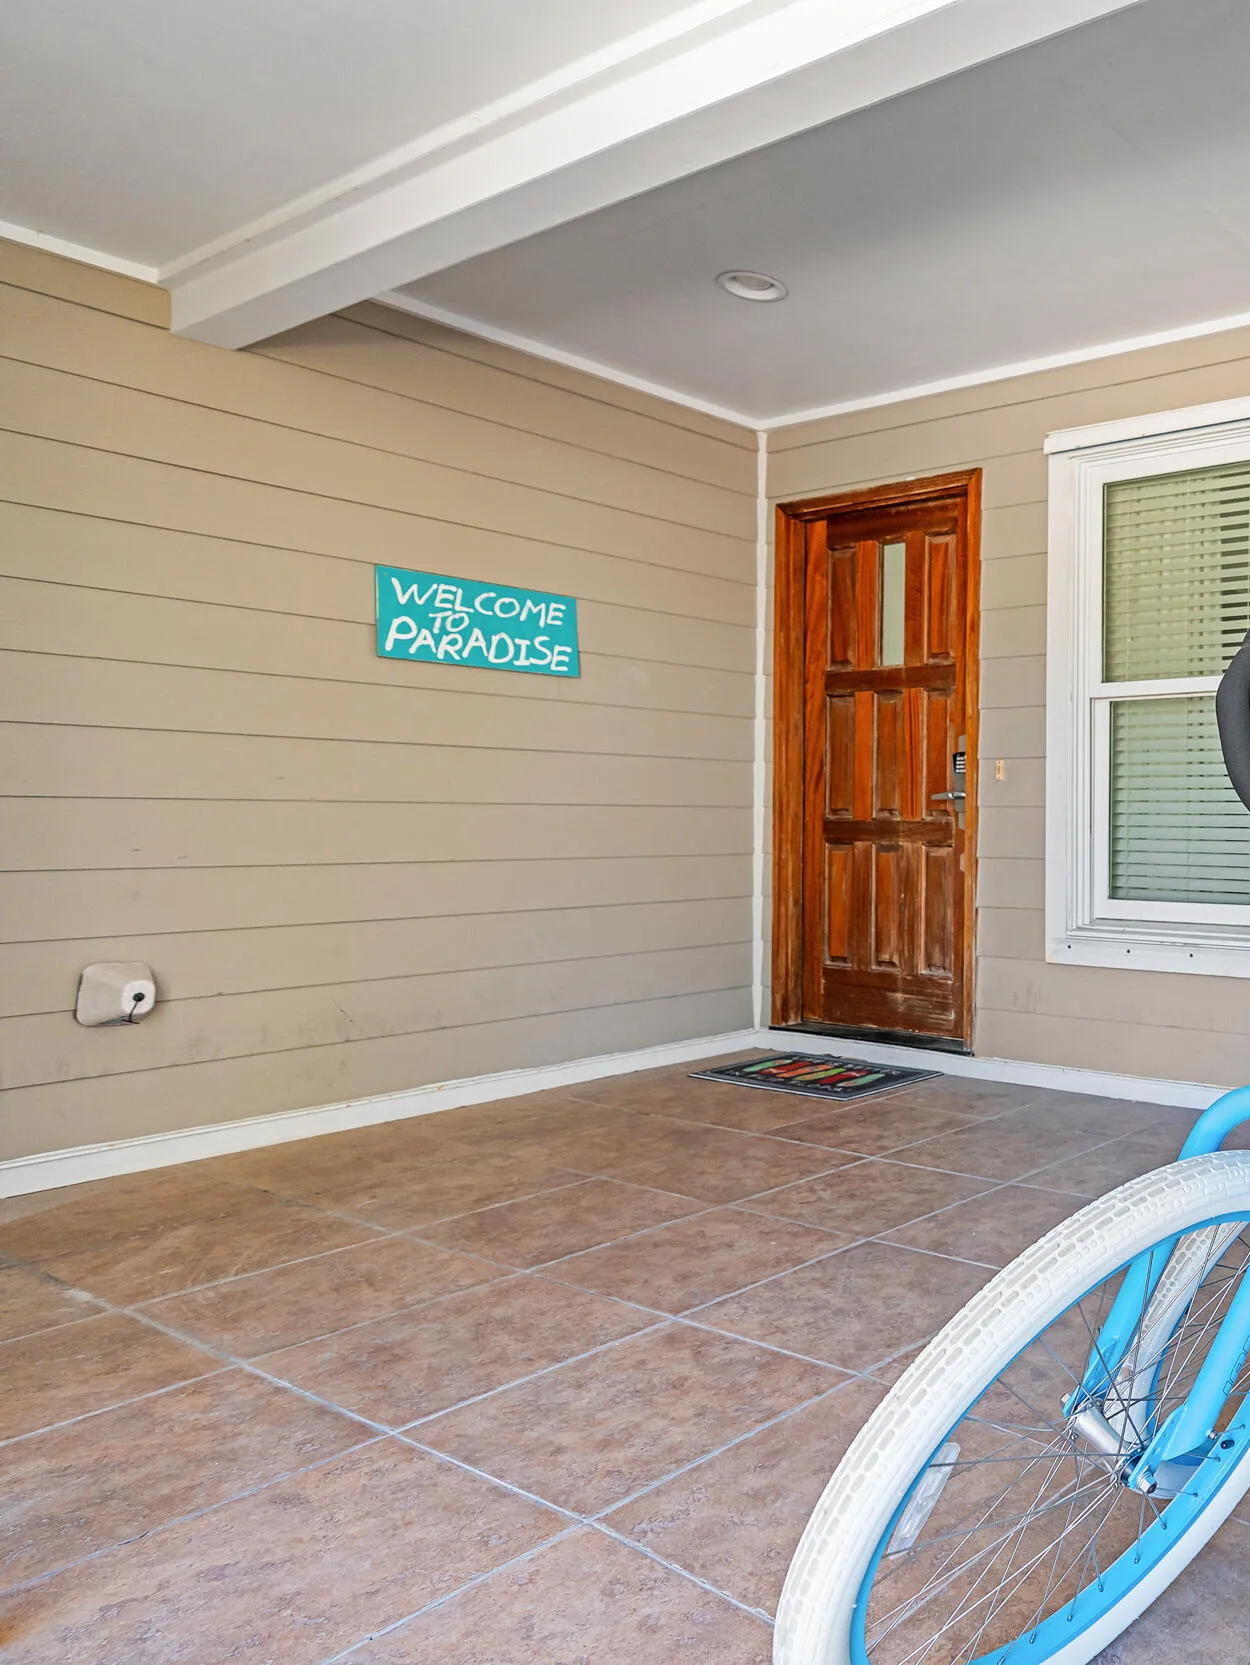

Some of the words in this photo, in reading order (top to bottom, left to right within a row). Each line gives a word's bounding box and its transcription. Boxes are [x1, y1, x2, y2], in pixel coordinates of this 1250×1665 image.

[390, 577, 567, 628] WELCOME
[428, 611, 470, 634] TO
[385, 615, 572, 672] PARADISE
